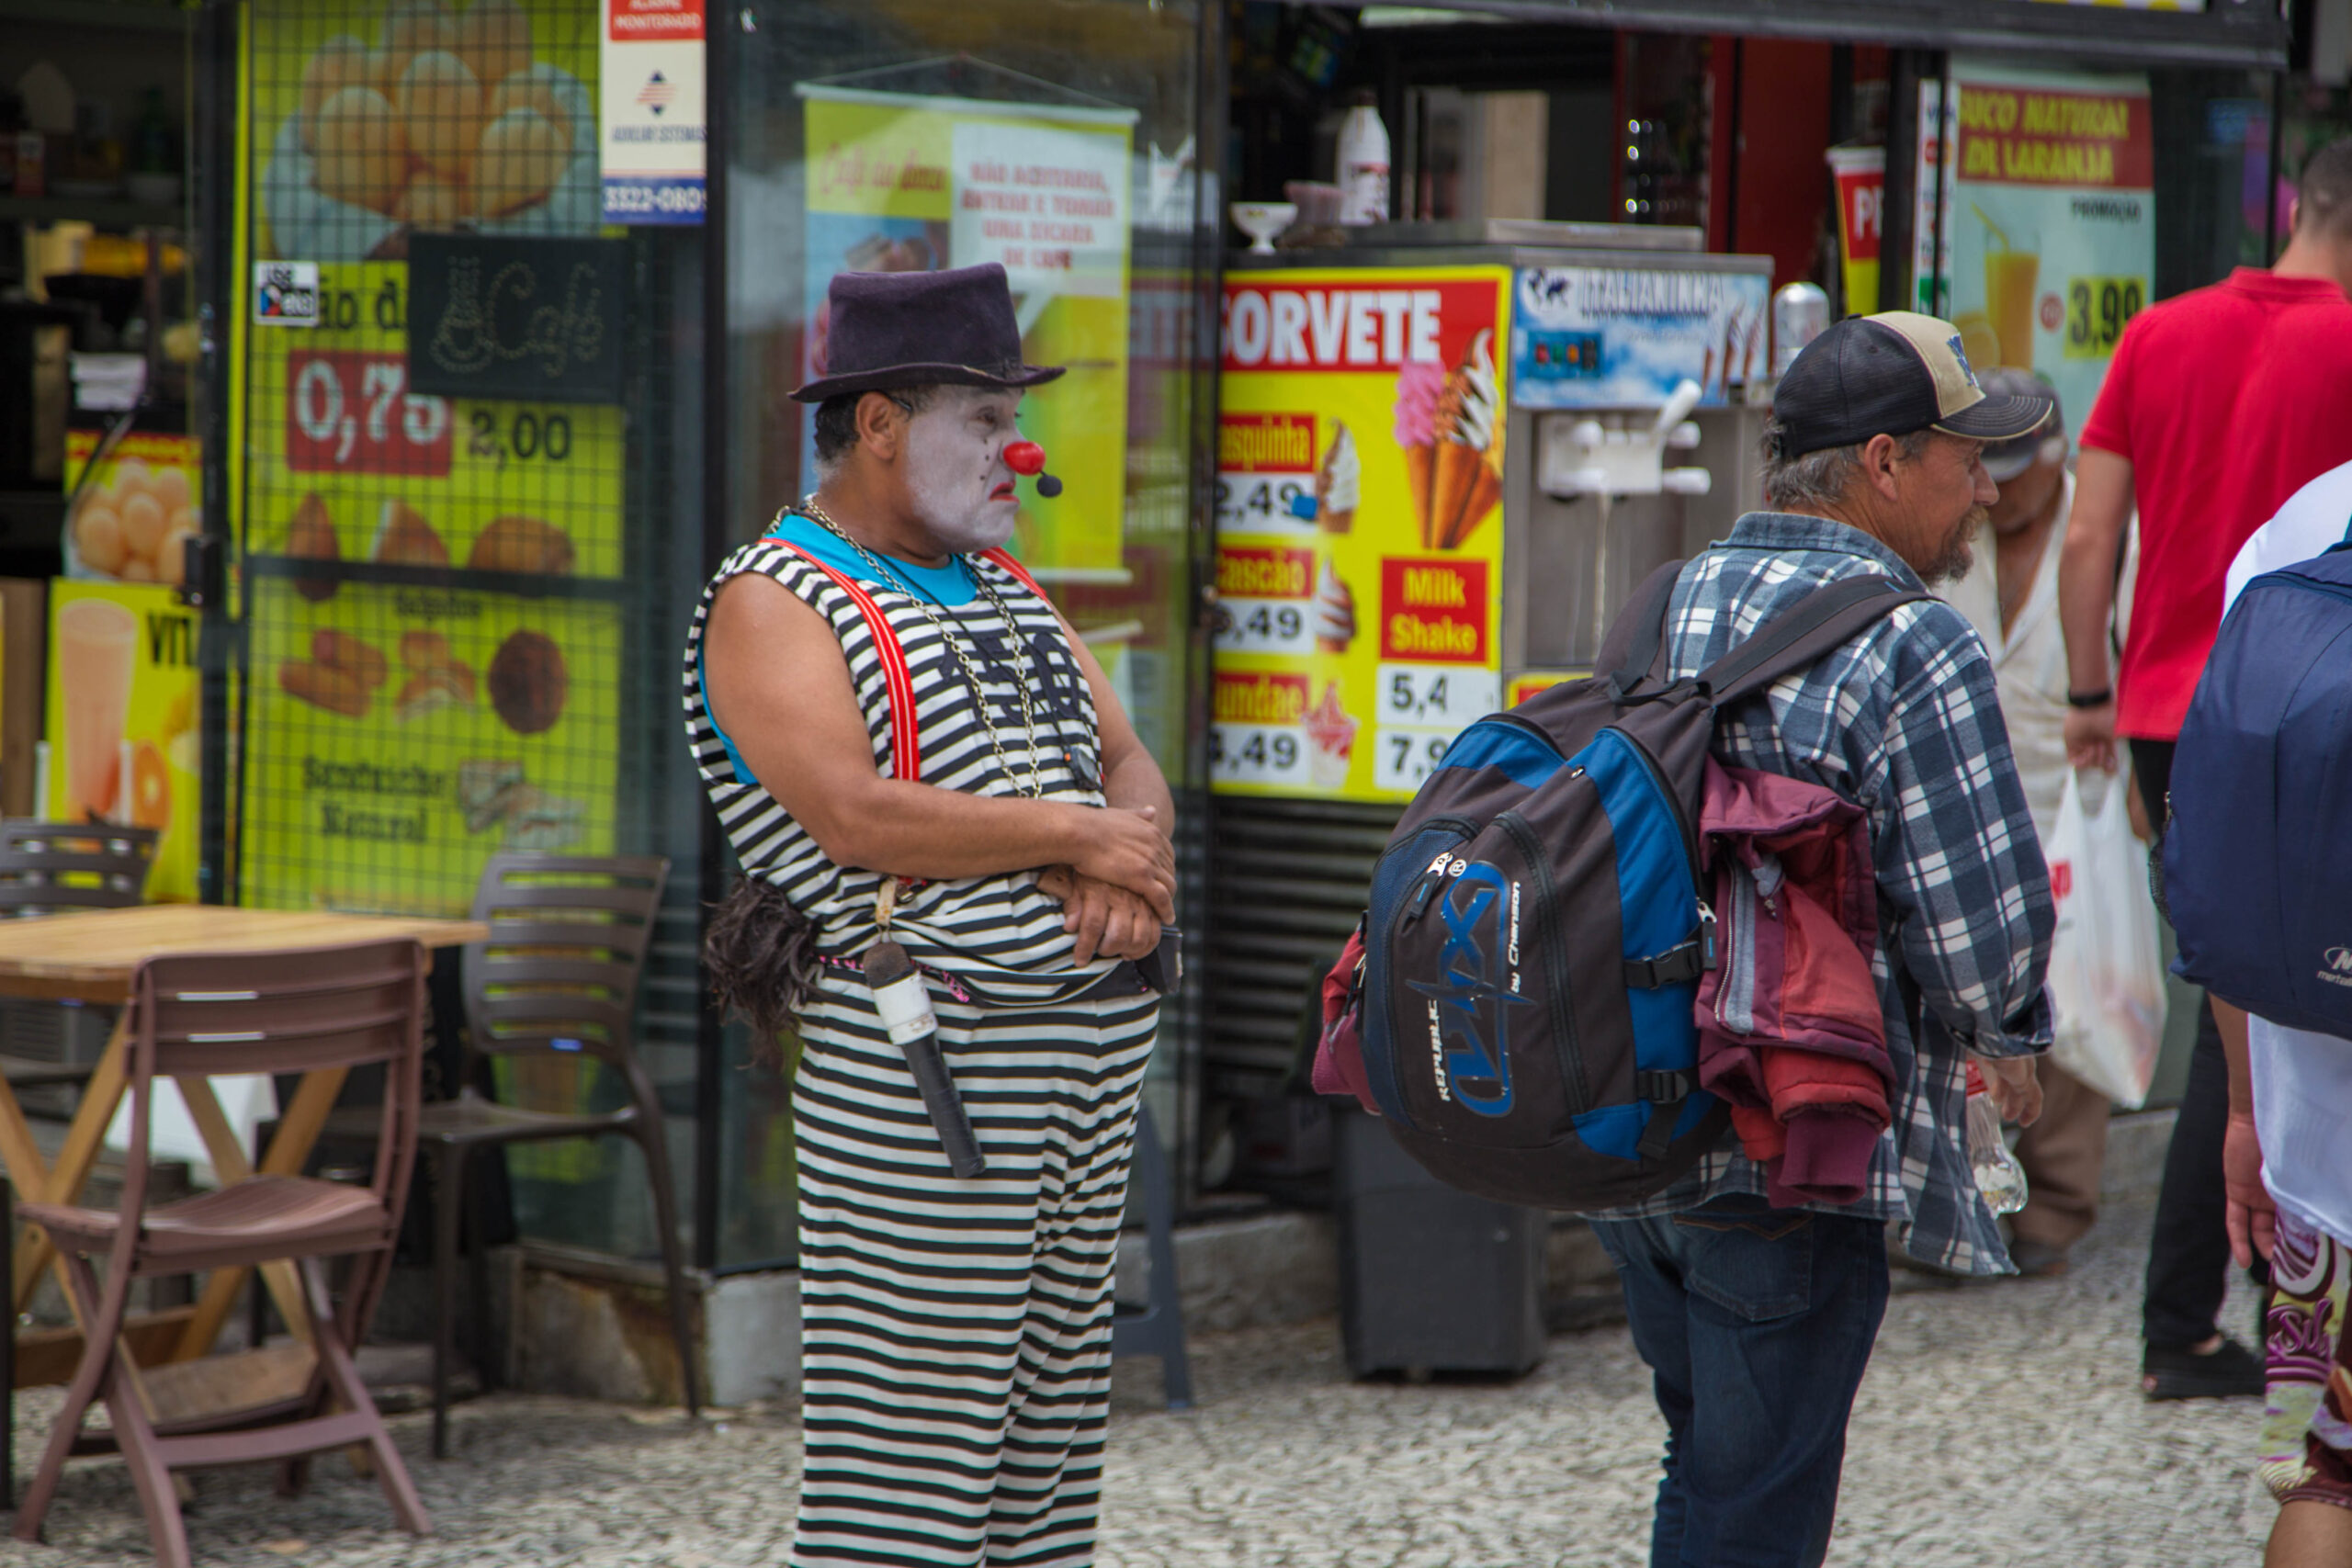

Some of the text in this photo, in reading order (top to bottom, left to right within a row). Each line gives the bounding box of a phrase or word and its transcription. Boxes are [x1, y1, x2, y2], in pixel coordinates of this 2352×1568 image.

[2004, 141, 2113, 184] LARANJA
[1220, 413, 1311, 472] asquinha
[1403, 567, 1466, 608] Milk
[147, 608, 194, 669] VIT
[1389, 613, 1478, 656] Shake
[1215, 674, 1305, 721] undae
[1511, 972, 1521, 993] by
[1427, 999, 1451, 1101] REPUBLIC
